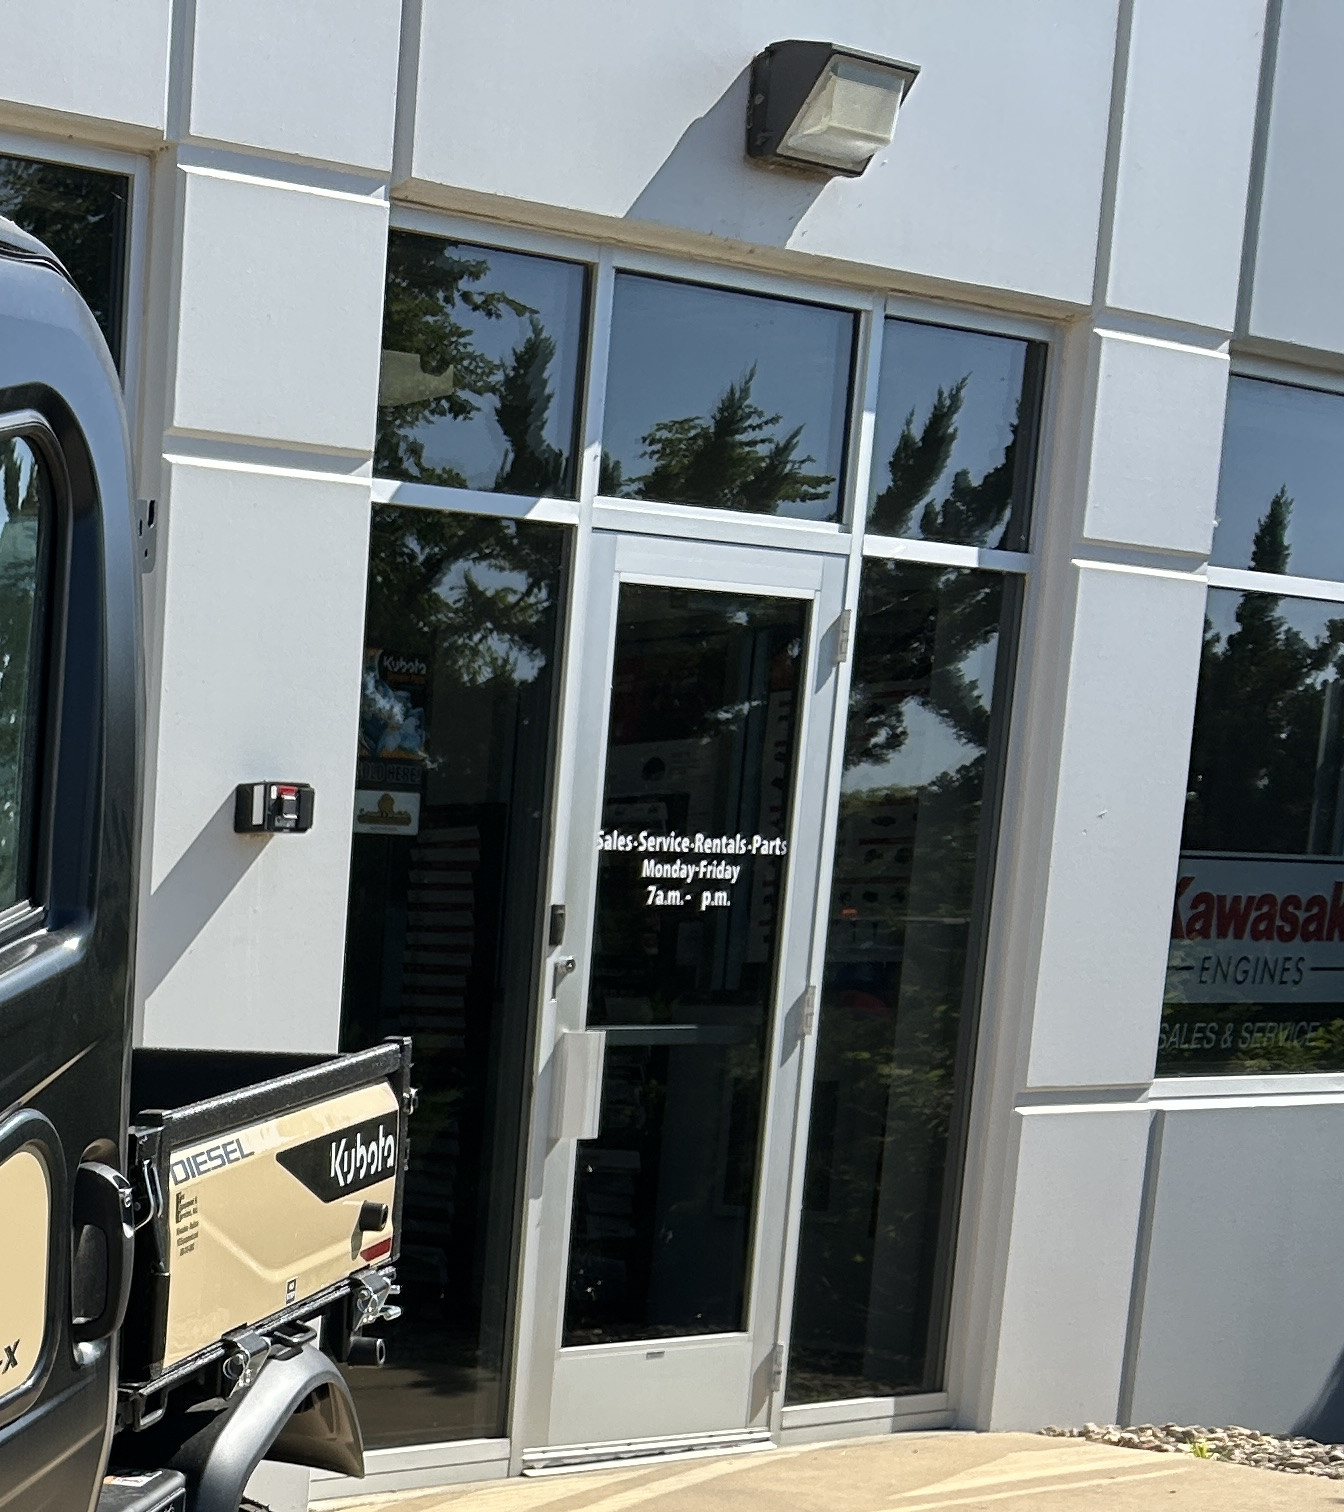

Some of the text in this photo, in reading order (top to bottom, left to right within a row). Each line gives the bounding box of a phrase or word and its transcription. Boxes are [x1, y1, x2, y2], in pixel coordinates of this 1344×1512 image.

[641, 859, 740, 883] Monday-Friday
[700, 890, 731, 911] p.m.
[1199, 956, 1305, 985] ENGINES
[1159, 1021, 1321, 1049] SALES & SERVICE
[170, 1138, 255, 1186] DIESEL
[329, 1125, 395, 1187] Kubota
